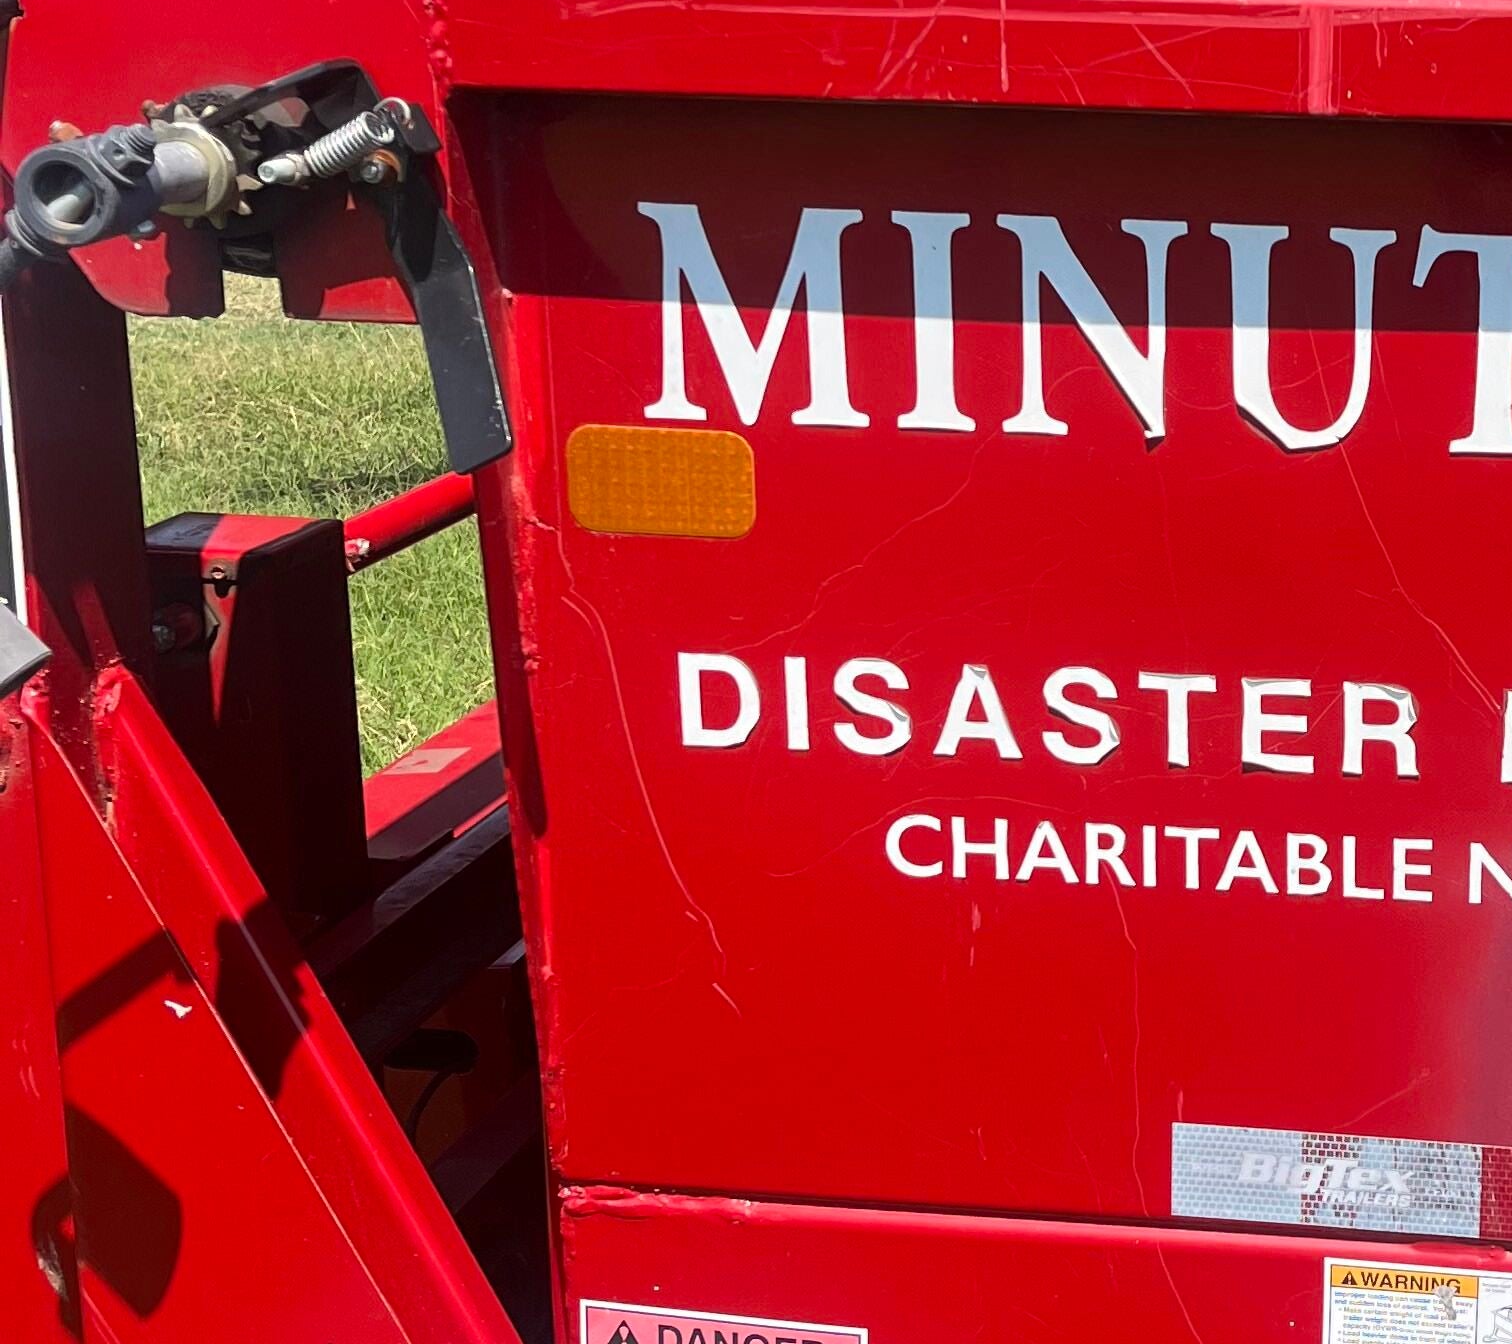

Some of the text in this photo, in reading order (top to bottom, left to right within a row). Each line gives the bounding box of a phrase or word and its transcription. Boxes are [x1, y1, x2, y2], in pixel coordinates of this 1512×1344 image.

[677, 651, 1419, 779] DISASTER
[885, 814, 1434, 902] CHARITABLE
[1322, 1189, 1412, 1208] TRAILERS
[1360, 1271, 1461, 1294] WARNING
